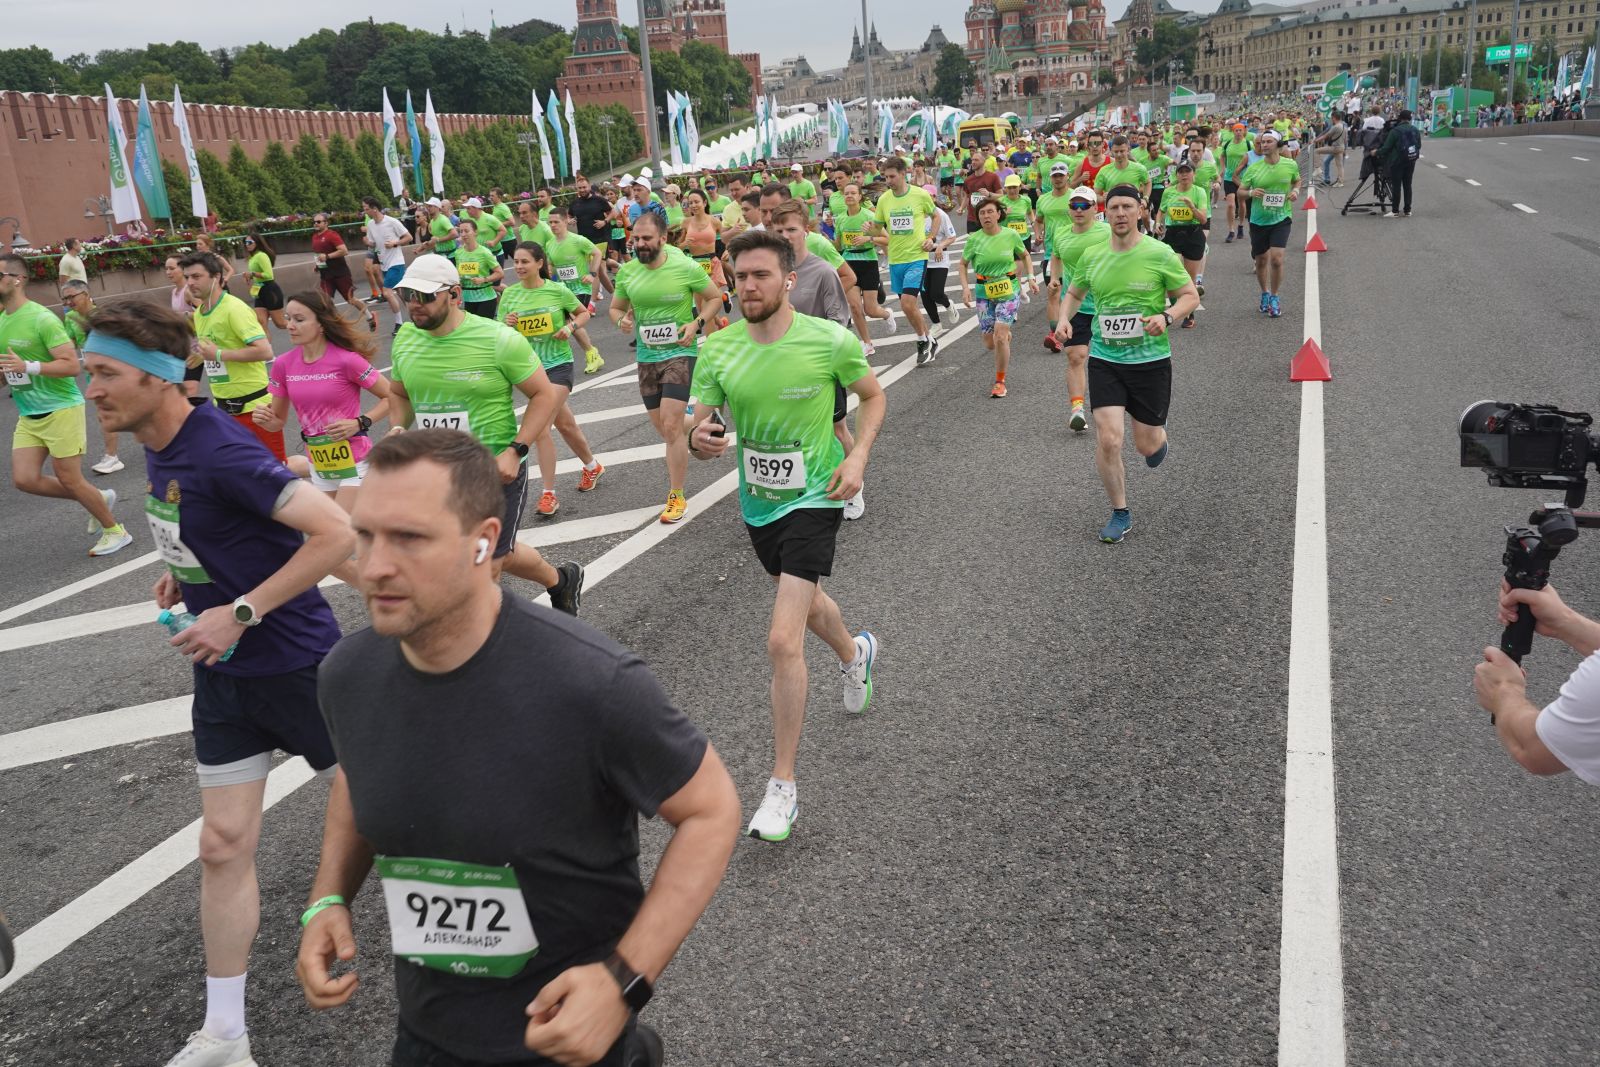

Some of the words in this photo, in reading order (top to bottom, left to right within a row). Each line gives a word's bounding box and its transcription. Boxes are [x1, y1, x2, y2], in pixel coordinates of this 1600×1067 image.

[1495, 47, 1530, 57] ПООГА
[1265, 195, 1283, 203] 8352
[1172, 208, 1190, 217] 7816
[892, 218, 911, 226] 8723
[559, 268, 575, 276] 8628
[988, 281, 1009, 293] 9190
[520, 317, 548, 330] 7224
[1104, 317, 1137, 331] 9677
[644, 326, 673, 339] 7442
[311, 445, 350, 463] 10140
[749, 455, 794, 478] 9599
[756, 475, 790, 486] АЛЕКСАНДР
[406, 892, 511, 932] 9272
[423, 931, 503, 949] АЛЕКСАНДР
